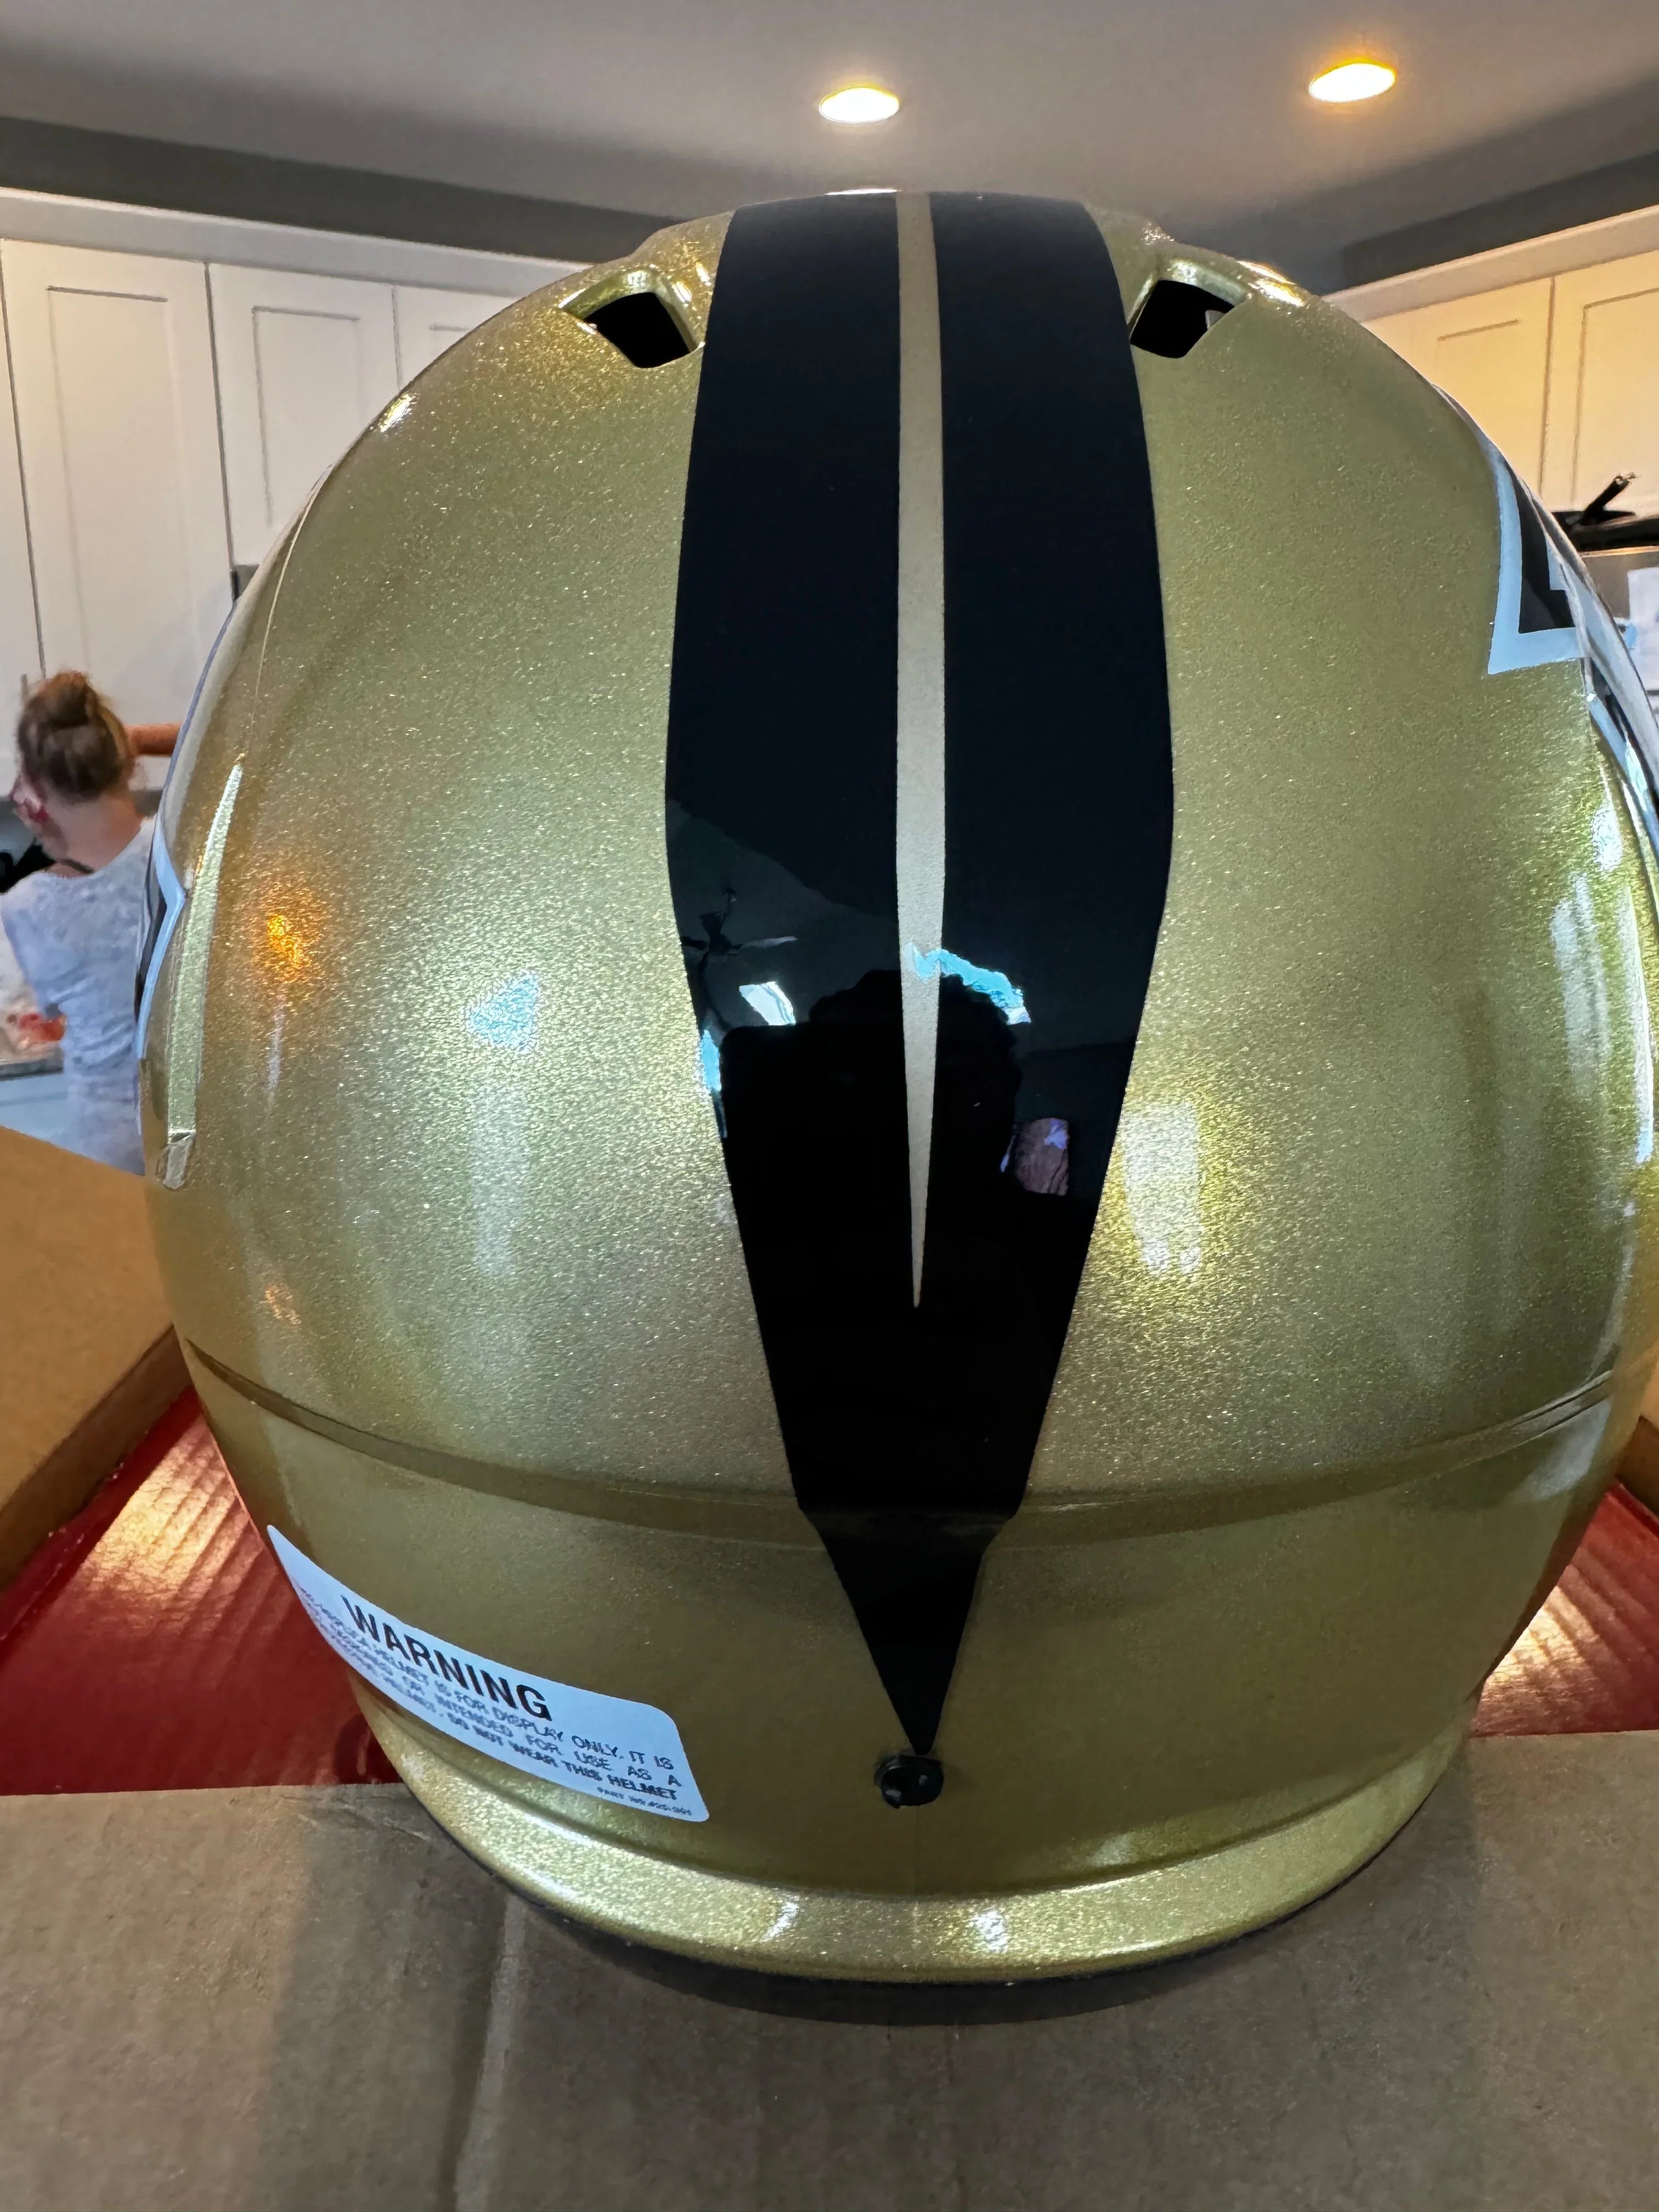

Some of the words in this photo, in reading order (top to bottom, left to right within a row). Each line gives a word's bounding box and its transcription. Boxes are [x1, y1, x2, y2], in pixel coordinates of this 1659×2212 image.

[341, 1594, 552, 1722] WARNING
[434, 1692, 514, 1738] INTENDED
[526, 1734, 564, 1756] FOR
[573, 1751, 614, 1771] USE
[628, 1765, 652, 1780] AS
[668, 1774, 684, 1787] A
[454, 1690, 489, 1714] FOR
[492, 1706, 564, 1742] DISPLAY
[629, 1750, 646, 1764] IT
[653, 1756, 674, 1770] IS
[508, 1740, 559, 1768] WEAR
[561, 1759, 603, 1781] THIS
[607, 1774, 677, 1800] HELMET
